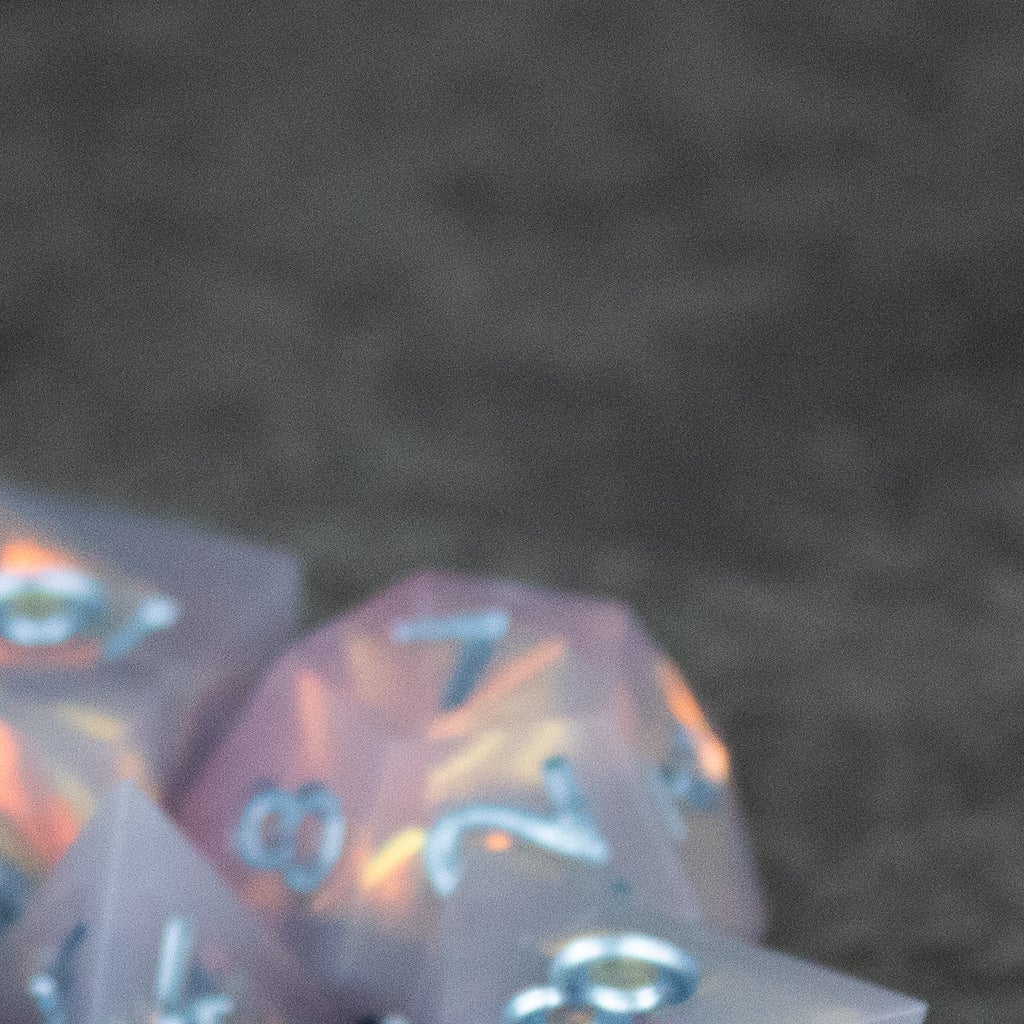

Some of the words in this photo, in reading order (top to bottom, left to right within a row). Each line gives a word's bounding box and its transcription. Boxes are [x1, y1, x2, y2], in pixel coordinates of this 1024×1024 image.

[393, 608, 511, 708] 7
[234, 778, 347, 892] 8
[423, 752, 613, 896] 2
